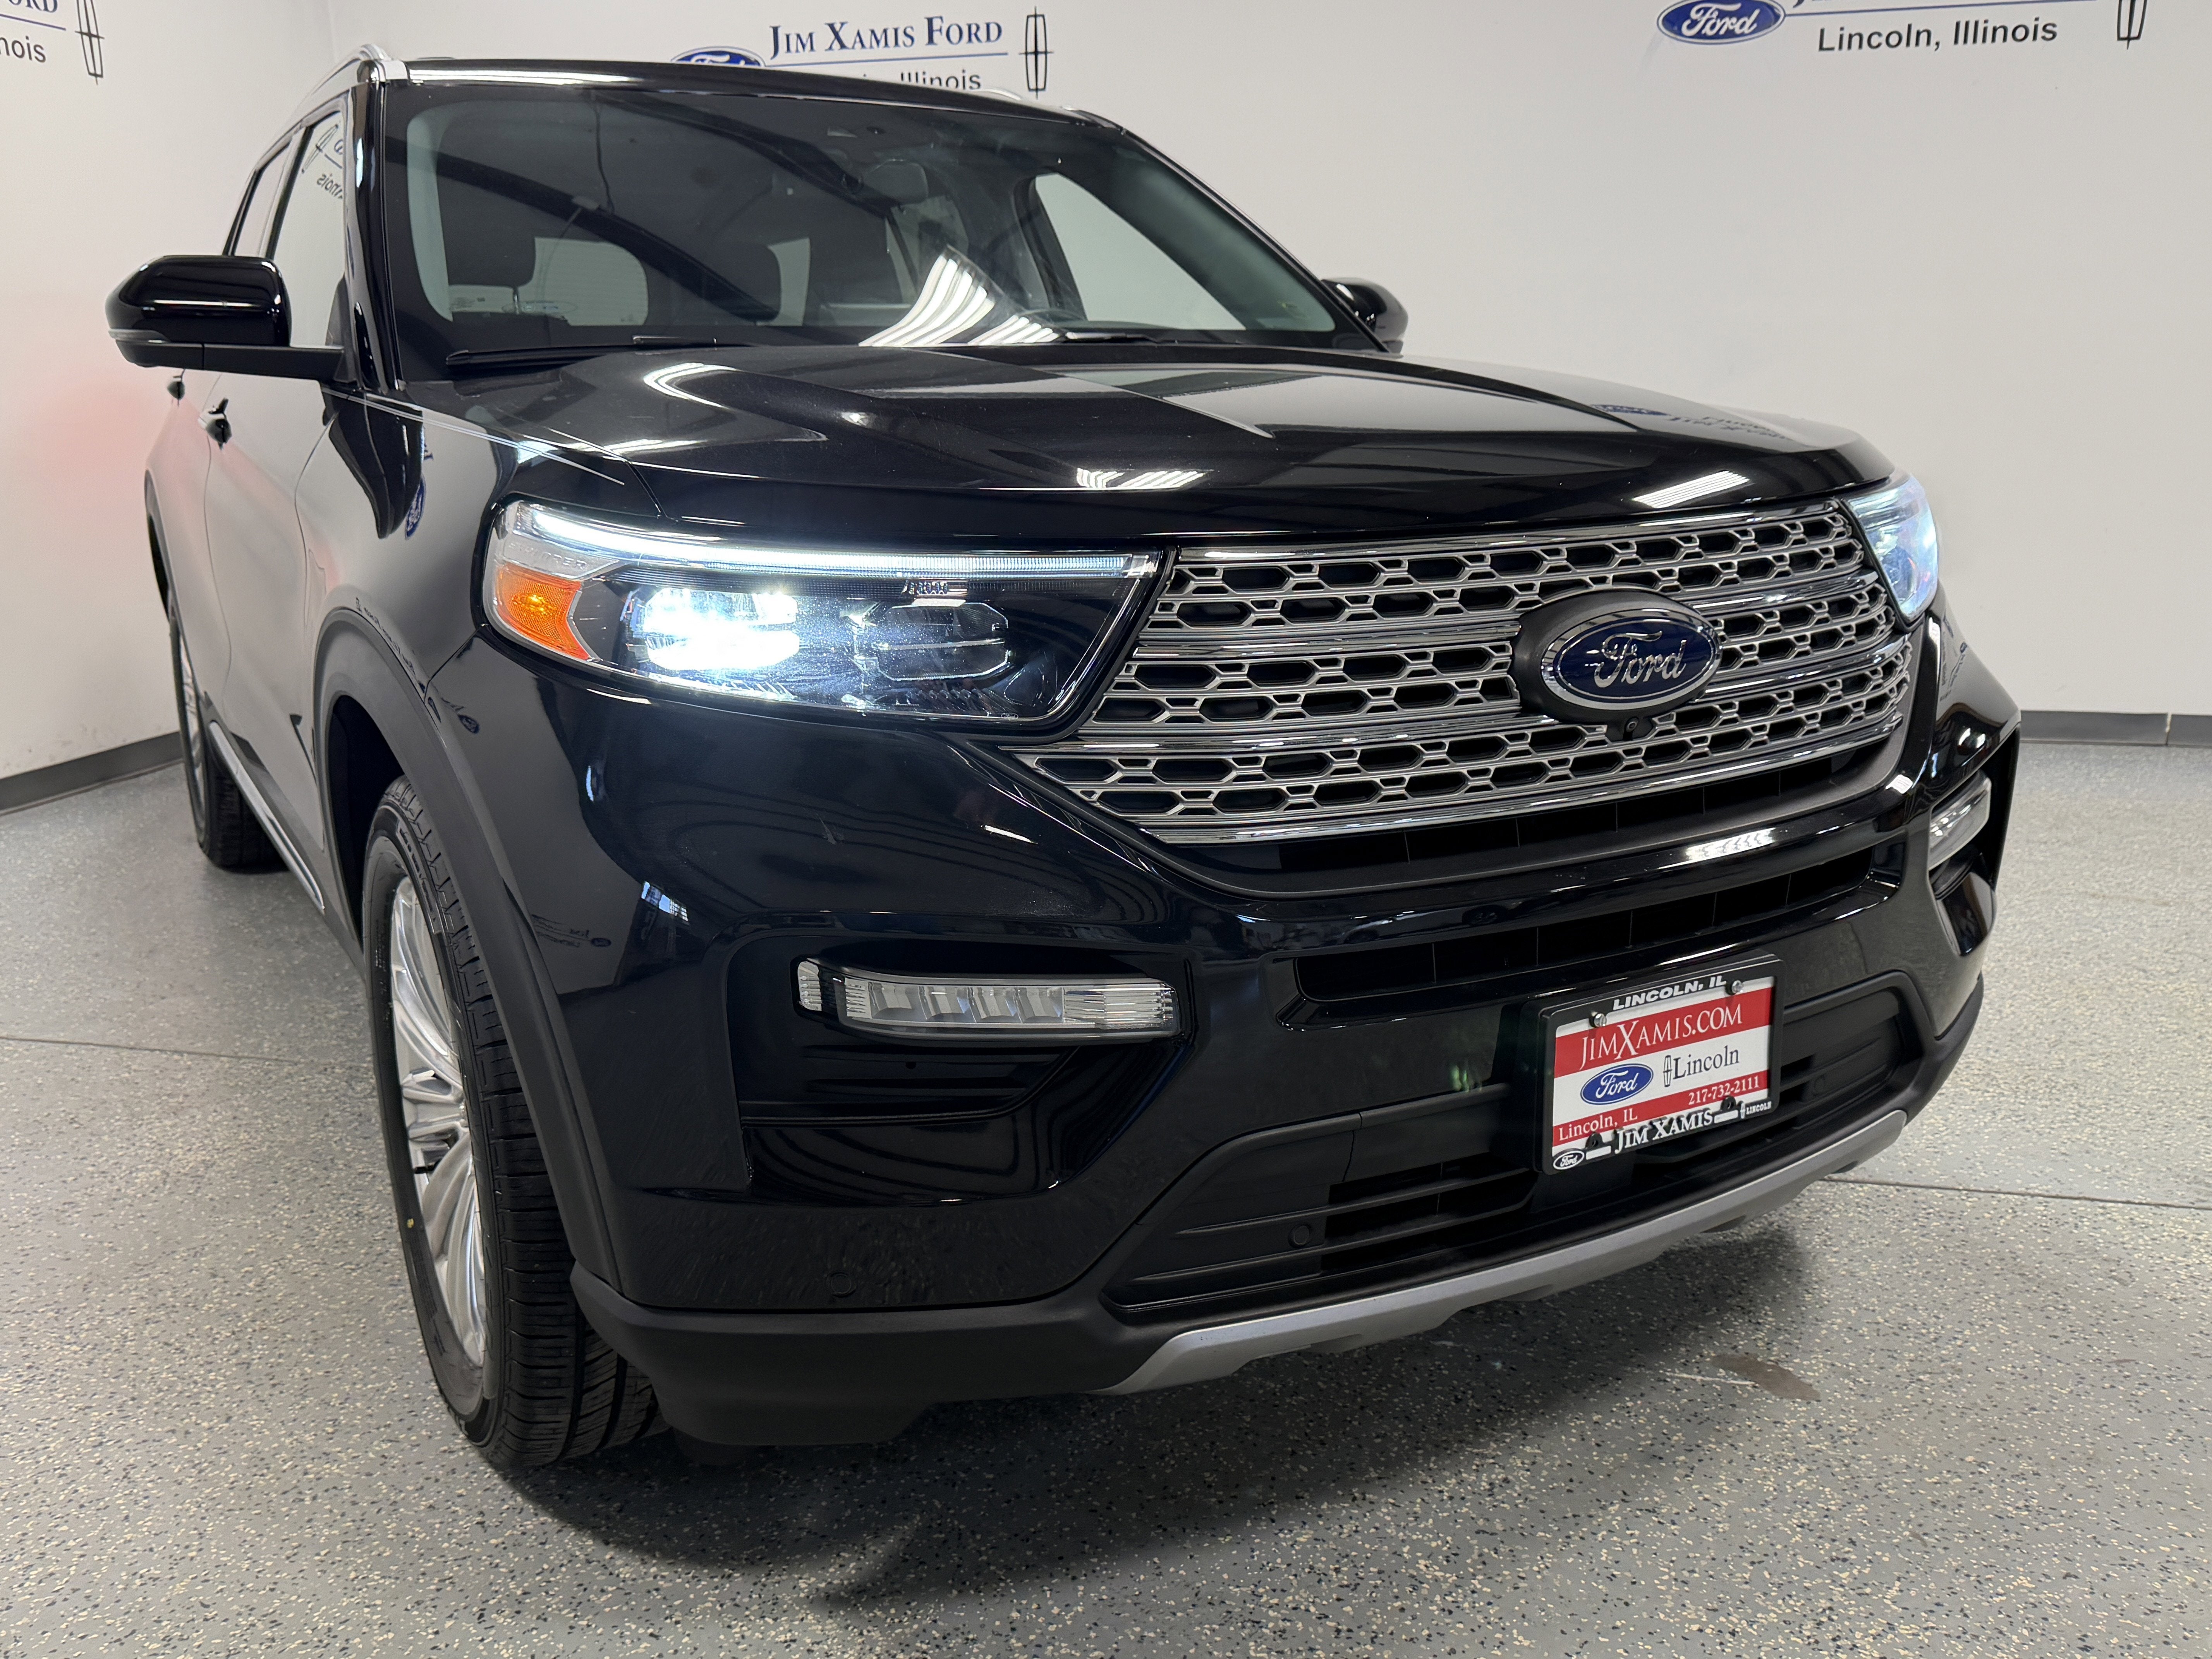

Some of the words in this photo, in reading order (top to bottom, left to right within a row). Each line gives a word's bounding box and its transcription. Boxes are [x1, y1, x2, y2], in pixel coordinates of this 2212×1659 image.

[1681, 3, 1760, 36] Ford
[1818, 24, 1941, 52] Lincoln,
[1953, 17, 2058, 45] Illinois
[769, 25, 815, 60] JIM
[824, 21, 915, 51] XAMIS
[924, 16, 1003, 46] FORD
[1594, 630, 1687, 688] Ford
[1613, 981, 1704, 1010] LINCOLN,
[1709, 975, 1726, 988] IL
[1579, 1003, 1743, 1070] JIMXAMIS.COM
[1673, 1045, 1740, 1080] Lincoln
[1595, 1070, 1638, 1099] Ford
[1688, 1076, 1760, 1105] 217-732-2111
[1559, 1115, 1618, 1141] Lincoln,
[1623, 1107, 1638, 1121] IL
[1746, 1101, 1772, 1115] LINCOLN
[1614, 1128, 1649, 1154] JIM
[1652, 1111, 1713, 1139] XAMIS
[1559, 1152, 1579, 1167] Ford
